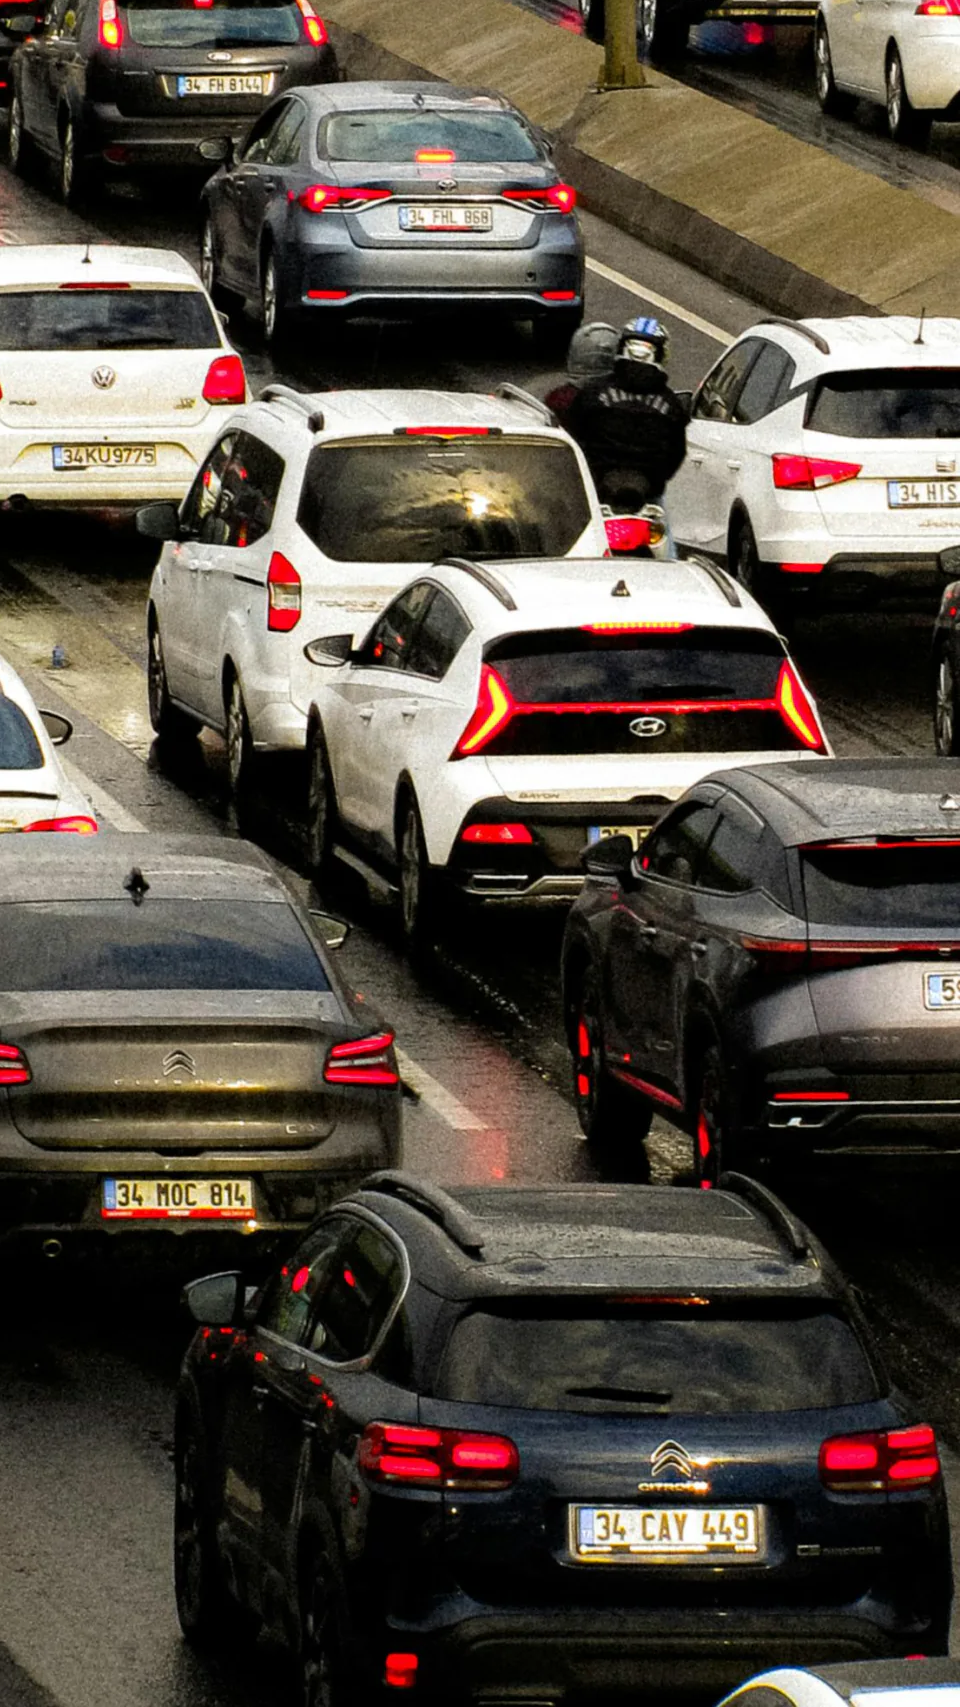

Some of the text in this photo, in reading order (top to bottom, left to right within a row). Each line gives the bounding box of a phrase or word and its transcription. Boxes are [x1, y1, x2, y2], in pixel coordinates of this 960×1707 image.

[185, 77, 260, 91] 34 FH 8144
[409, 210, 425, 223] 34
[433, 210, 457, 223] FHL
[900, 484, 957, 502] 34 HIS
[117, 1182, 246, 1206] 34 MOC 814
[596, 1512, 749, 1541] 34 CAY 449
